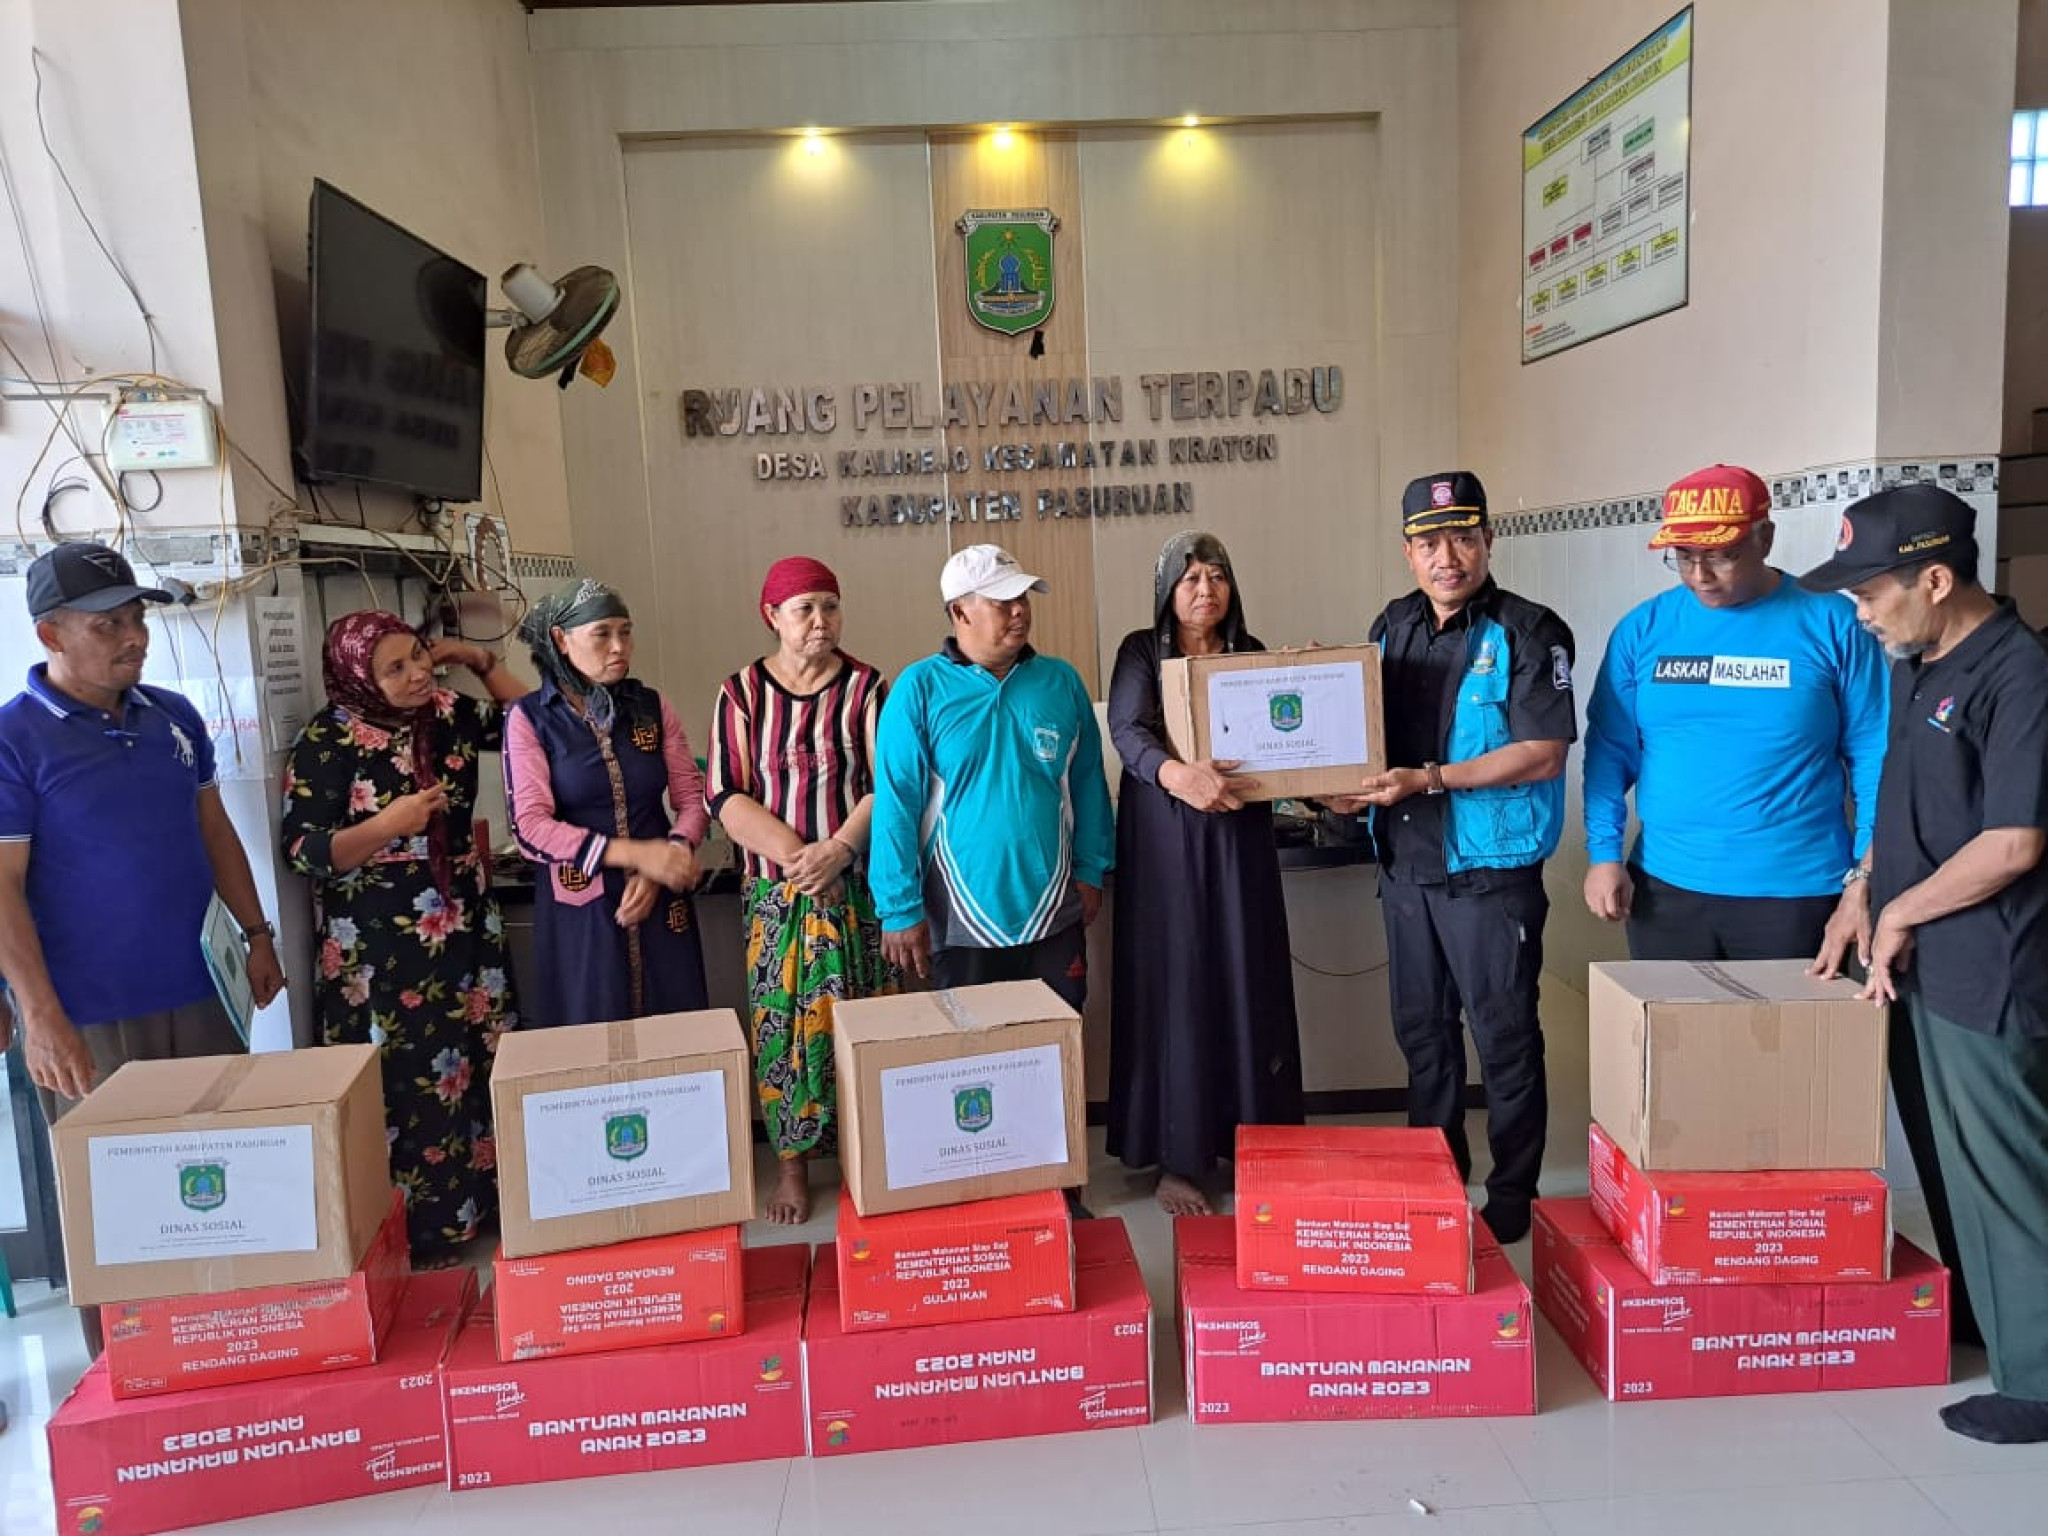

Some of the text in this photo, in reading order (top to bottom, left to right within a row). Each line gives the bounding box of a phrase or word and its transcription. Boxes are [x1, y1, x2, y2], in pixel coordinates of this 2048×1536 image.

[682, 365, 1345, 438] RUANG PELAYANAN TERPADU
[755, 450, 828, 481] DESA
[982, 438, 1158, 474] KECAMATAN
[1168, 433, 1279, 466] KRATON
[839, 482, 1193, 528] KABUPATEN PASURUAN
[1667, 487, 1745, 516] TAGANA
[1655, 659, 1787, 681] LASKAR MASLAHAT
[626, 1166, 666, 1181] SOSIAL
[160, 1219, 246, 1234] DINAS SOSIAL
[1709, 1218, 1827, 1229] KEMENTERIAN SOSIAL
[1709, 1228, 1826, 1239] REPUBLIK INDONESIA
[1296, 1229, 1412, 1241] KEMENTERIAN SOSIAL
[1296, 1239, 1412, 1250] REPUBLIK INDONESIA
[1755, 1243, 1783, 1253] 2023
[896, 1250, 1010, 1270] KEMENTERIAN SOSIAL
[1341, 1253, 1370, 1264] 2023
[1714, 1255, 1819, 1266] RENDANG DAGING
[566, 1265, 675, 1286] RENDANG DAGING
[896, 1260, 1012, 1280] REPUBLIK INDONESIA
[1303, 1264, 1405, 1277] RENDANG DAGING
[604, 1283, 634, 1296] 2023
[941, 1278, 970, 1291] 2023
[559, 1292, 682, 1314] REPUBLIK INDONESIA
[923, 1290, 988, 1306] GULAI IKAN
[171, 1310, 304, 1336] KEMENTERIAN SOSIAL
[561, 1303, 682, 1323] KEMENTERIAN SOSIAL
[173, 1320, 304, 1346] REPUBLIK INDONESIA
[1114, 1323, 1144, 1336] 2023
[1691, 1326, 1897, 1351] BANTUAN MAKANAN
[226, 1338, 259, 1354] 2023
[182, 1346, 299, 1373] RENDANG DAGING
[915, 1347, 1036, 1373] ANAK 2023
[1260, 1358, 1471, 1376] BANTUAN MAKANAN
[1737, 1349, 1856, 1370] ANAK 2023
[400, 1374, 433, 1390] 2023
[875, 1376, 979, 1399] MAKANAN
[982, 1366, 1085, 1389] BANTUAN
[1622, 1380, 1654, 1394] 2023
[1308, 1380, 1431, 1397] ANAK 2023
[1199, 1402, 1230, 1414] 2023
[528, 1411, 637, 1437] BANTUAN
[640, 1402, 747, 1425] MAKANAN
[163, 1415, 304, 1451] ANAK 2023
[581, 1428, 707, 1454] ANAK 2023
[243, 1427, 361, 1461] BANTUAN
[117, 1449, 239, 1482] MAKANAN
[458, 1472, 492, 1486] 2023
